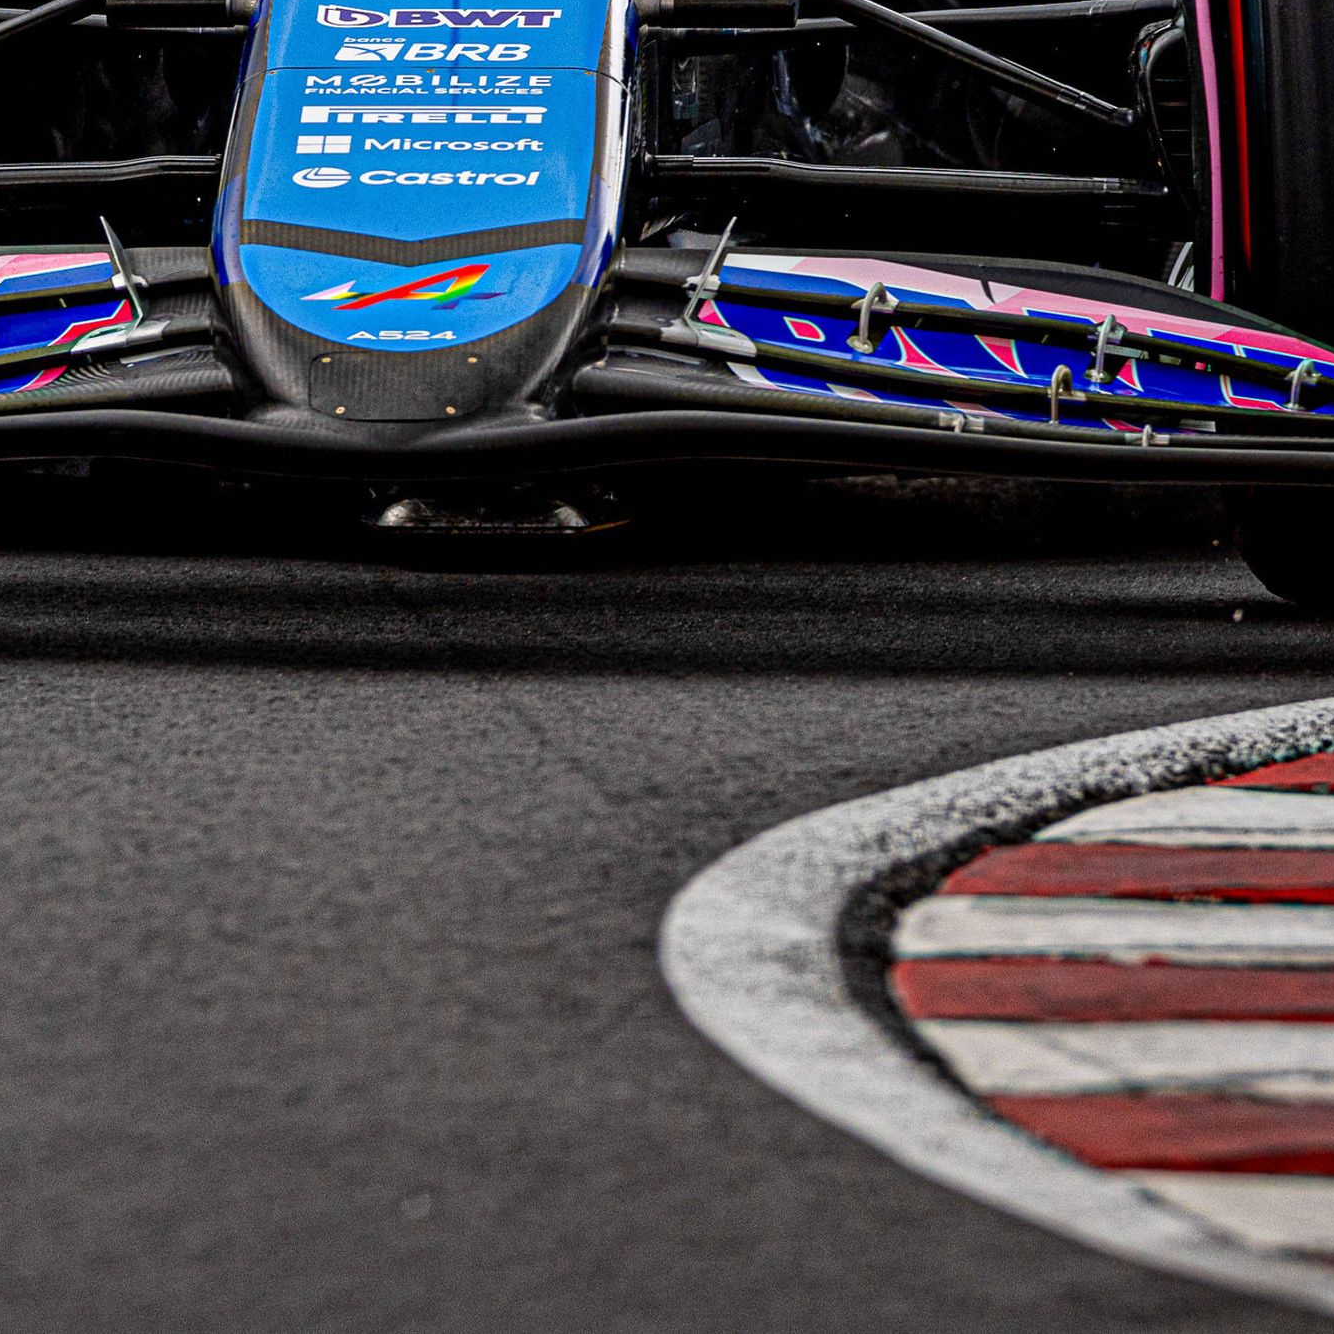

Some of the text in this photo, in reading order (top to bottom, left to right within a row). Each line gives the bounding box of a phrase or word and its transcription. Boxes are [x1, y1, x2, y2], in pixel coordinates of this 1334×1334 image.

[388, 9, 562, 28] BWT
[403, 43, 532, 62] BRB
[304, 87, 544, 95] FINANCIAL SERVICES
[300, 105, 548, 124] PIRELLI
[363, 138, 544, 152] Microsoft
[359, 169, 540, 186] Castrol
[346, 330, 457, 341] A524
